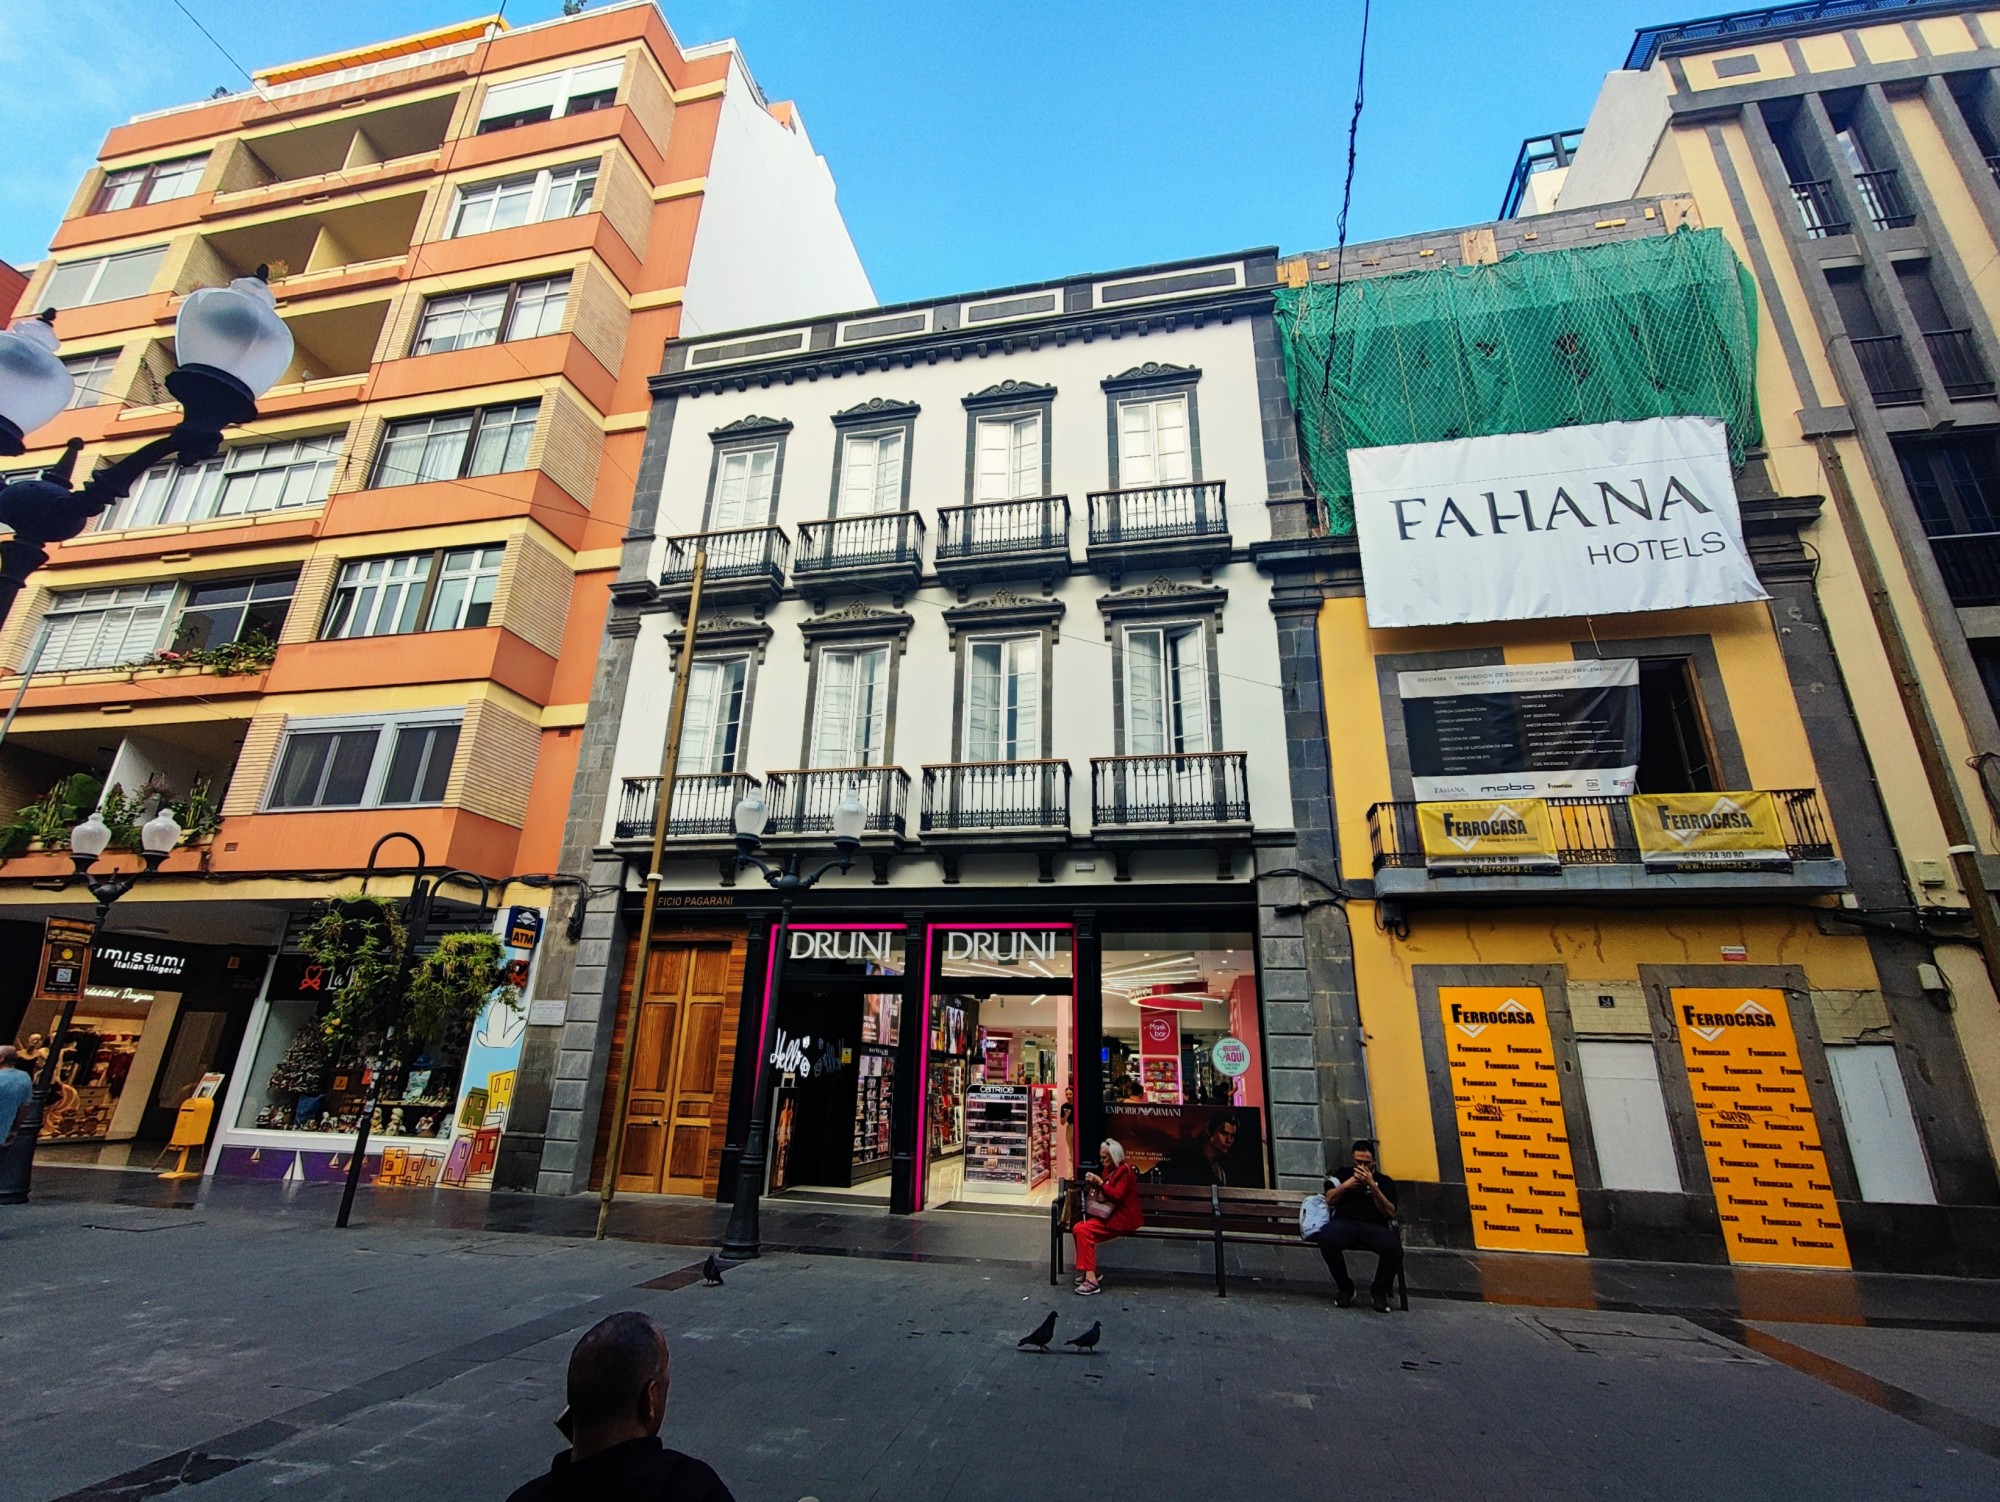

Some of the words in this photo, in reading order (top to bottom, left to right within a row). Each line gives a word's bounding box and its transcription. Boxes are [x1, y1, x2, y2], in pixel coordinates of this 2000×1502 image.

[1389, 475, 1713, 541] FAHANA
[1587, 531, 1726, 565] HOTELS
[1434, 786, 1466, 794] FAHANA
[1481, 782, 1535, 792] moba
[1657, 806, 1754, 830] FERROCASA
[1443, 812, 1528, 836] FERROCASA
[1709, 851, 1719, 859] 24
[1456, 864, 1533, 874] www.ferrocasa.es
[643, 896, 682, 907] EFICIO
[684, 896, 734, 906] PAGARANI
[512, 931, 534, 945] ATM
[790, 931, 893, 960] DRUNI
[947, 931, 1057, 960] DRUNI
[95, 947, 186, 968] imissimi
[114, 960, 144, 971] Italian
[146, 963, 182, 975] lingerie
[1451, 1004, 1536, 1025] FERROCASA
[1682, 1004, 1776, 1028] FERROCASA
[1457, 1044, 1492, 1053] FERROCASA
[1507, 1045, 1542, 1054] FERROCASA
[1692, 1047, 1730, 1056] FERROCASA
[1748, 1048, 1787, 1057] FERROCASA
[1226, 1050, 1244, 1062] AQUÍ
[1485, 1061, 1520, 1070] FERROCASA
[1724, 1066, 1763, 1074] FERROCASA
[1462, 1078, 1497, 1086] FERROCASA
[1512, 1078, 1548, 1088] FERROCASA
[1702, 1082, 1740, 1092] FERROCASA
[1756, 1084, 1796, 1093] FERROCASA
[1492, 1095, 1527, 1105] FERROCASA
[1105, 1106, 1140, 1116] EMPORIO
[1150, 1107, 1182, 1117] ARMANI
[1734, 1102, 1773, 1112] FERROCASA
[1467, 1112, 1502, 1122] FERROCASA
[1517, 1113, 1553, 1124] FERROCASA
[1710, 1120, 1750, 1130] FERROCASA
[1764, 1121, 1804, 1131] FERROCASA
[1496, 1130, 1532, 1140] FERROCASA
[1742, 1139, 1782, 1150] FERROCASA
[1473, 1147, 1508, 1158] FERROCASA
[1523, 1149, 1560, 1160] FERROCASA
[1719, 1157, 1760, 1168] FERROCASA
[1774, 1159, 1815, 1170] FERROCASA
[1502, 1166, 1538, 1178] FERROCASA
[1753, 1177, 1794, 1188] FERROCASA
[1478, 1183, 1514, 1194] FERROCASA
[1528, 1186, 1566, 1197] FERROCASA
[1728, 1195, 1768, 1206] FERROCASA
[1783, 1198, 1824, 1209] FERROCASA
[1506, 1204, 1544, 1215] FERROCASA
[1484, 1221, 1520, 1232] FERROCASA
[1761, 1215, 1802, 1227] FERROCASA
[1535, 1224, 1573, 1235] FERROCASA
[1738, 1233, 1778, 1245] FERROCASA
[1792, 1237, 1834, 1248] FERROCASA
